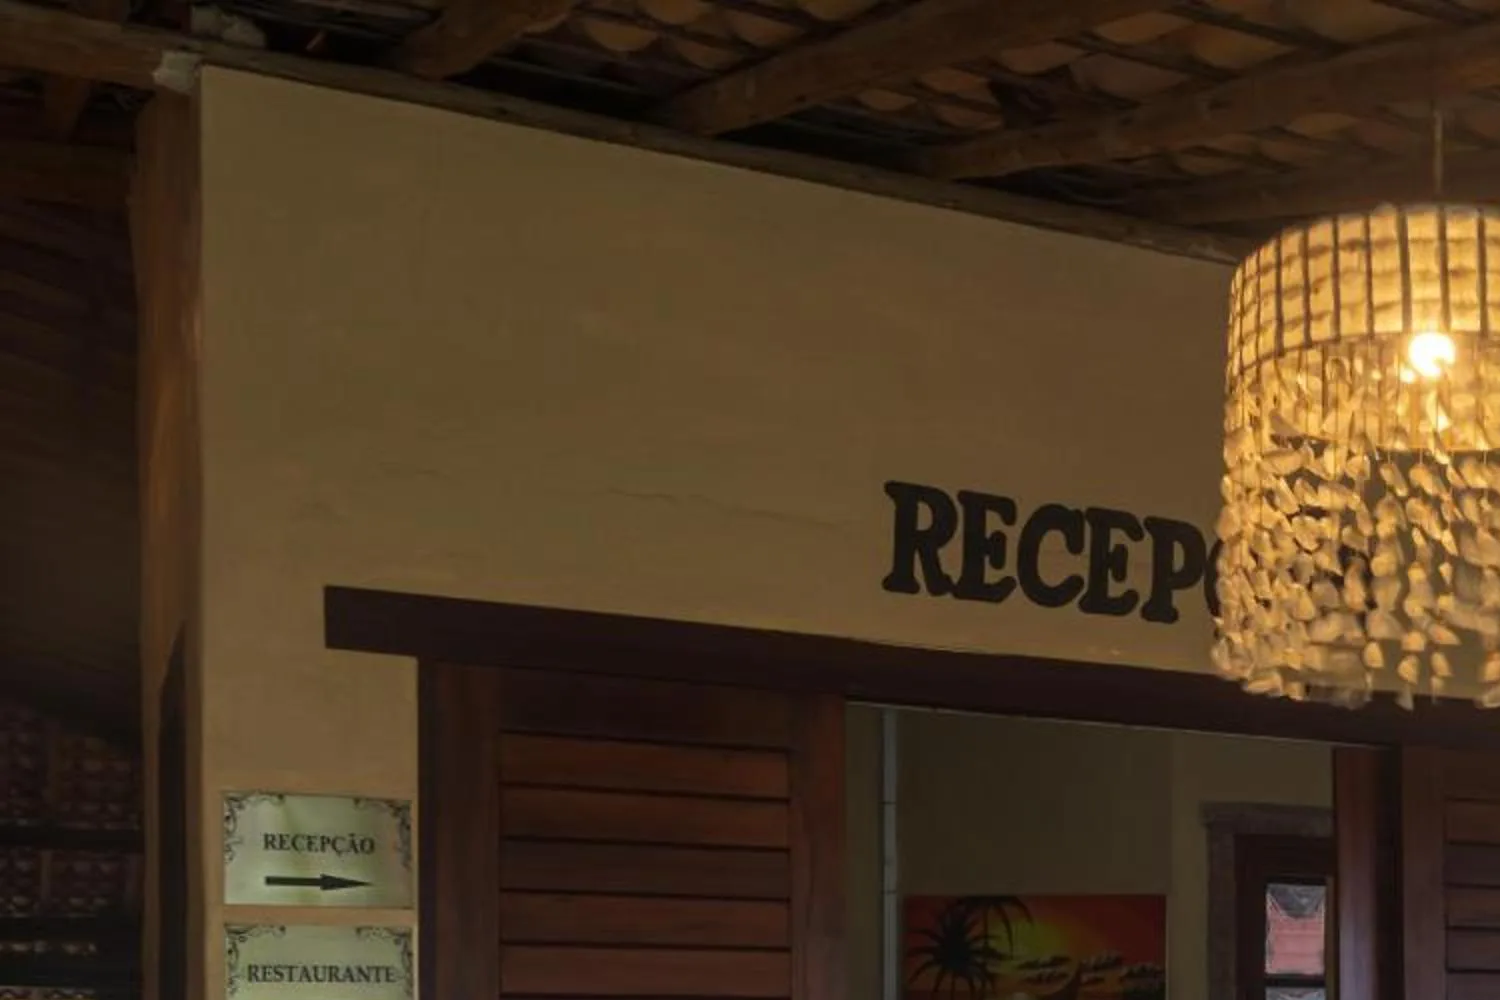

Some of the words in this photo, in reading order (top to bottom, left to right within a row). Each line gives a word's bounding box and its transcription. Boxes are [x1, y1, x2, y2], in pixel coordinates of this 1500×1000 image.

[882, 480, 1224, 624] RECEP
[263, 832, 376, 855] RECEPÇÃO
[247, 964, 397, 983] RESTAURANTE
